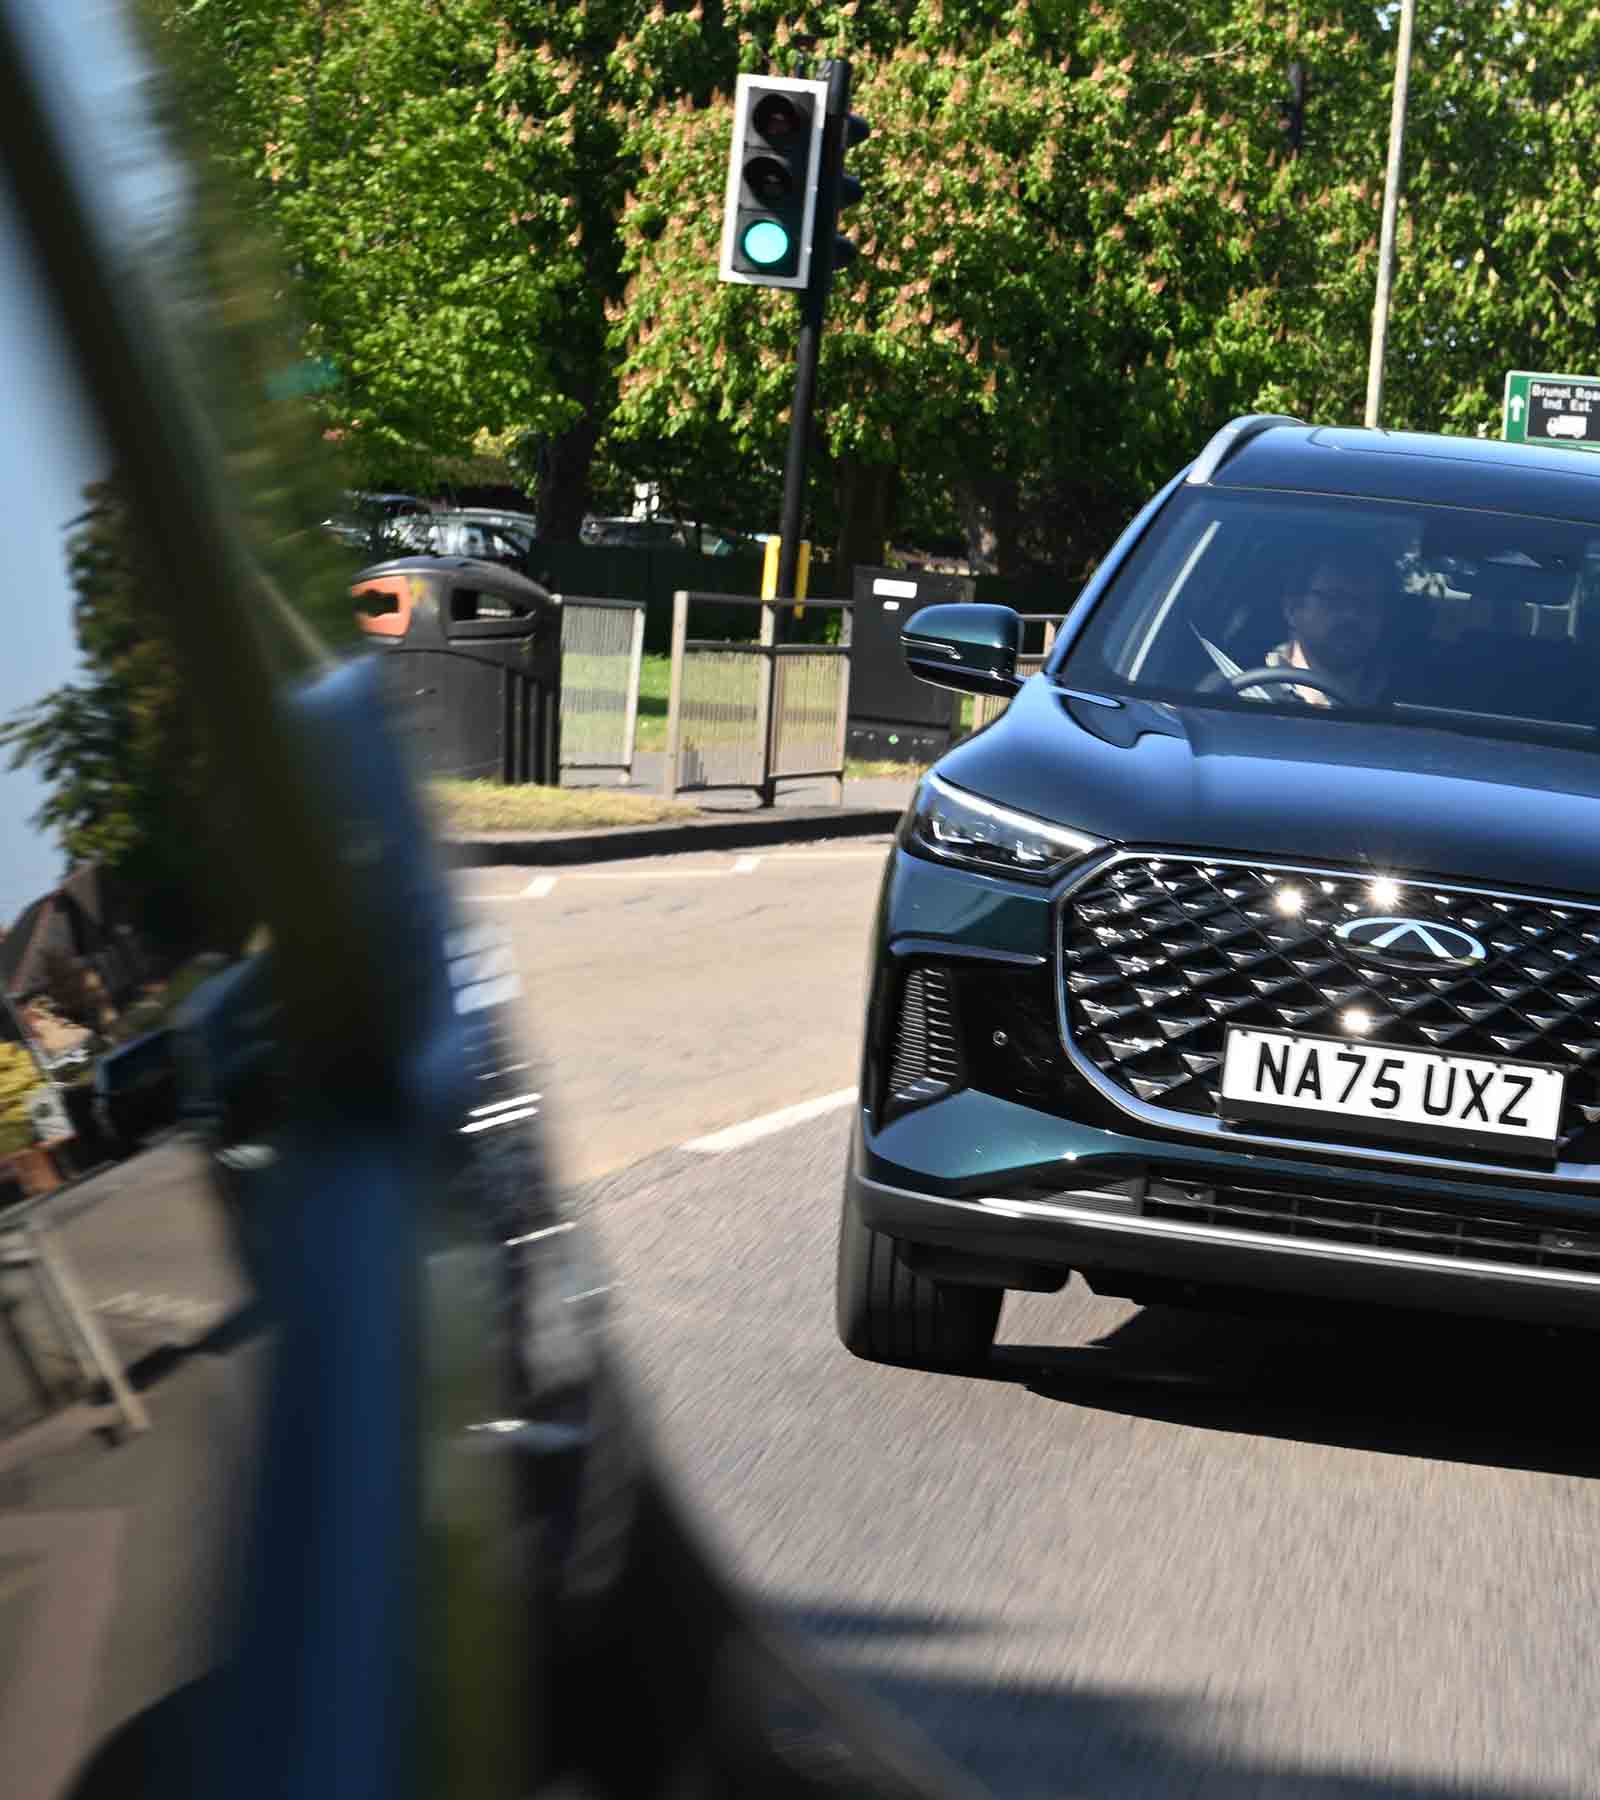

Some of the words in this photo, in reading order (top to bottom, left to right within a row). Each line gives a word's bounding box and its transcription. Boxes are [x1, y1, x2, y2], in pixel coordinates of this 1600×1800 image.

[1542, 398, 1565, 411] Ind.
[1569, 399, 1593, 412] Est.
[1254, 1041, 1405, 1110] NA75
[1422, 1063, 1533, 1127] UXZ
